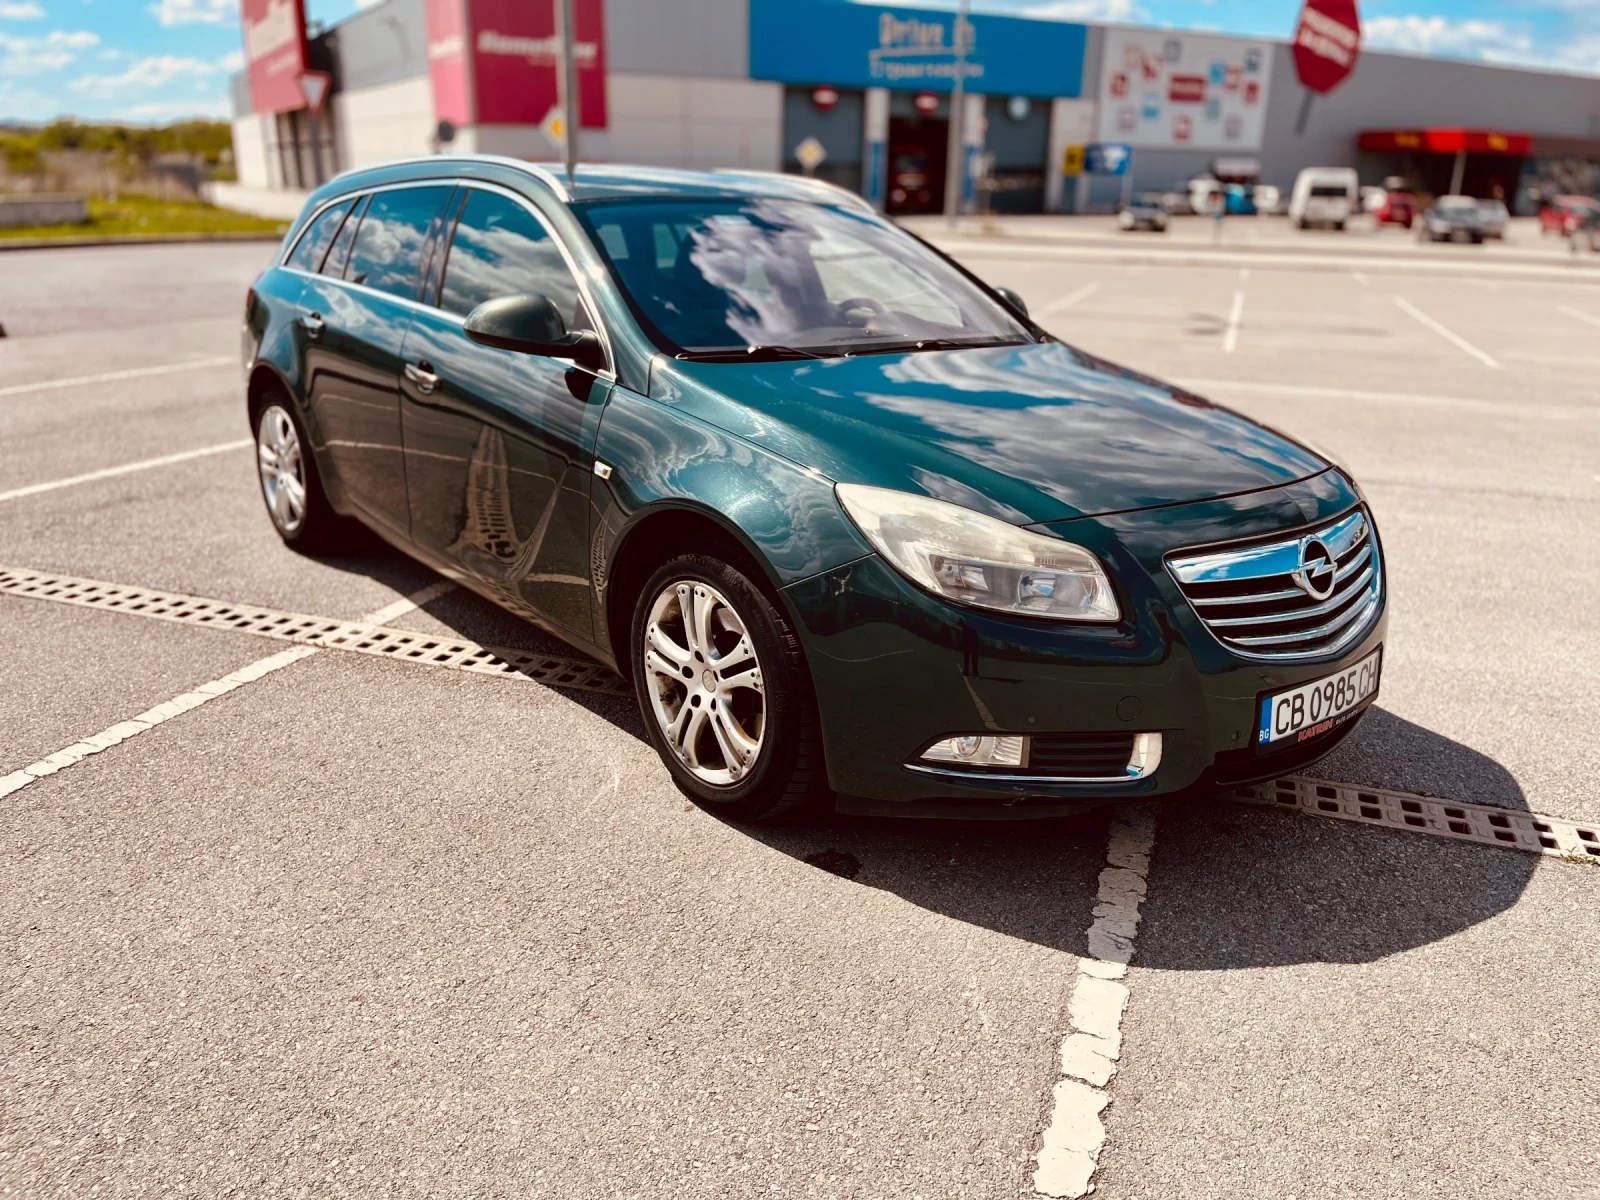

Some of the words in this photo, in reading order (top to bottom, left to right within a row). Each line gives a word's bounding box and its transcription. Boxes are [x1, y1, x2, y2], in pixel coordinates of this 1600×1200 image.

[1275, 692, 1305, 735] CB
[1310, 670, 1357, 722] 0985
[1259, 728, 1270, 741] BG
